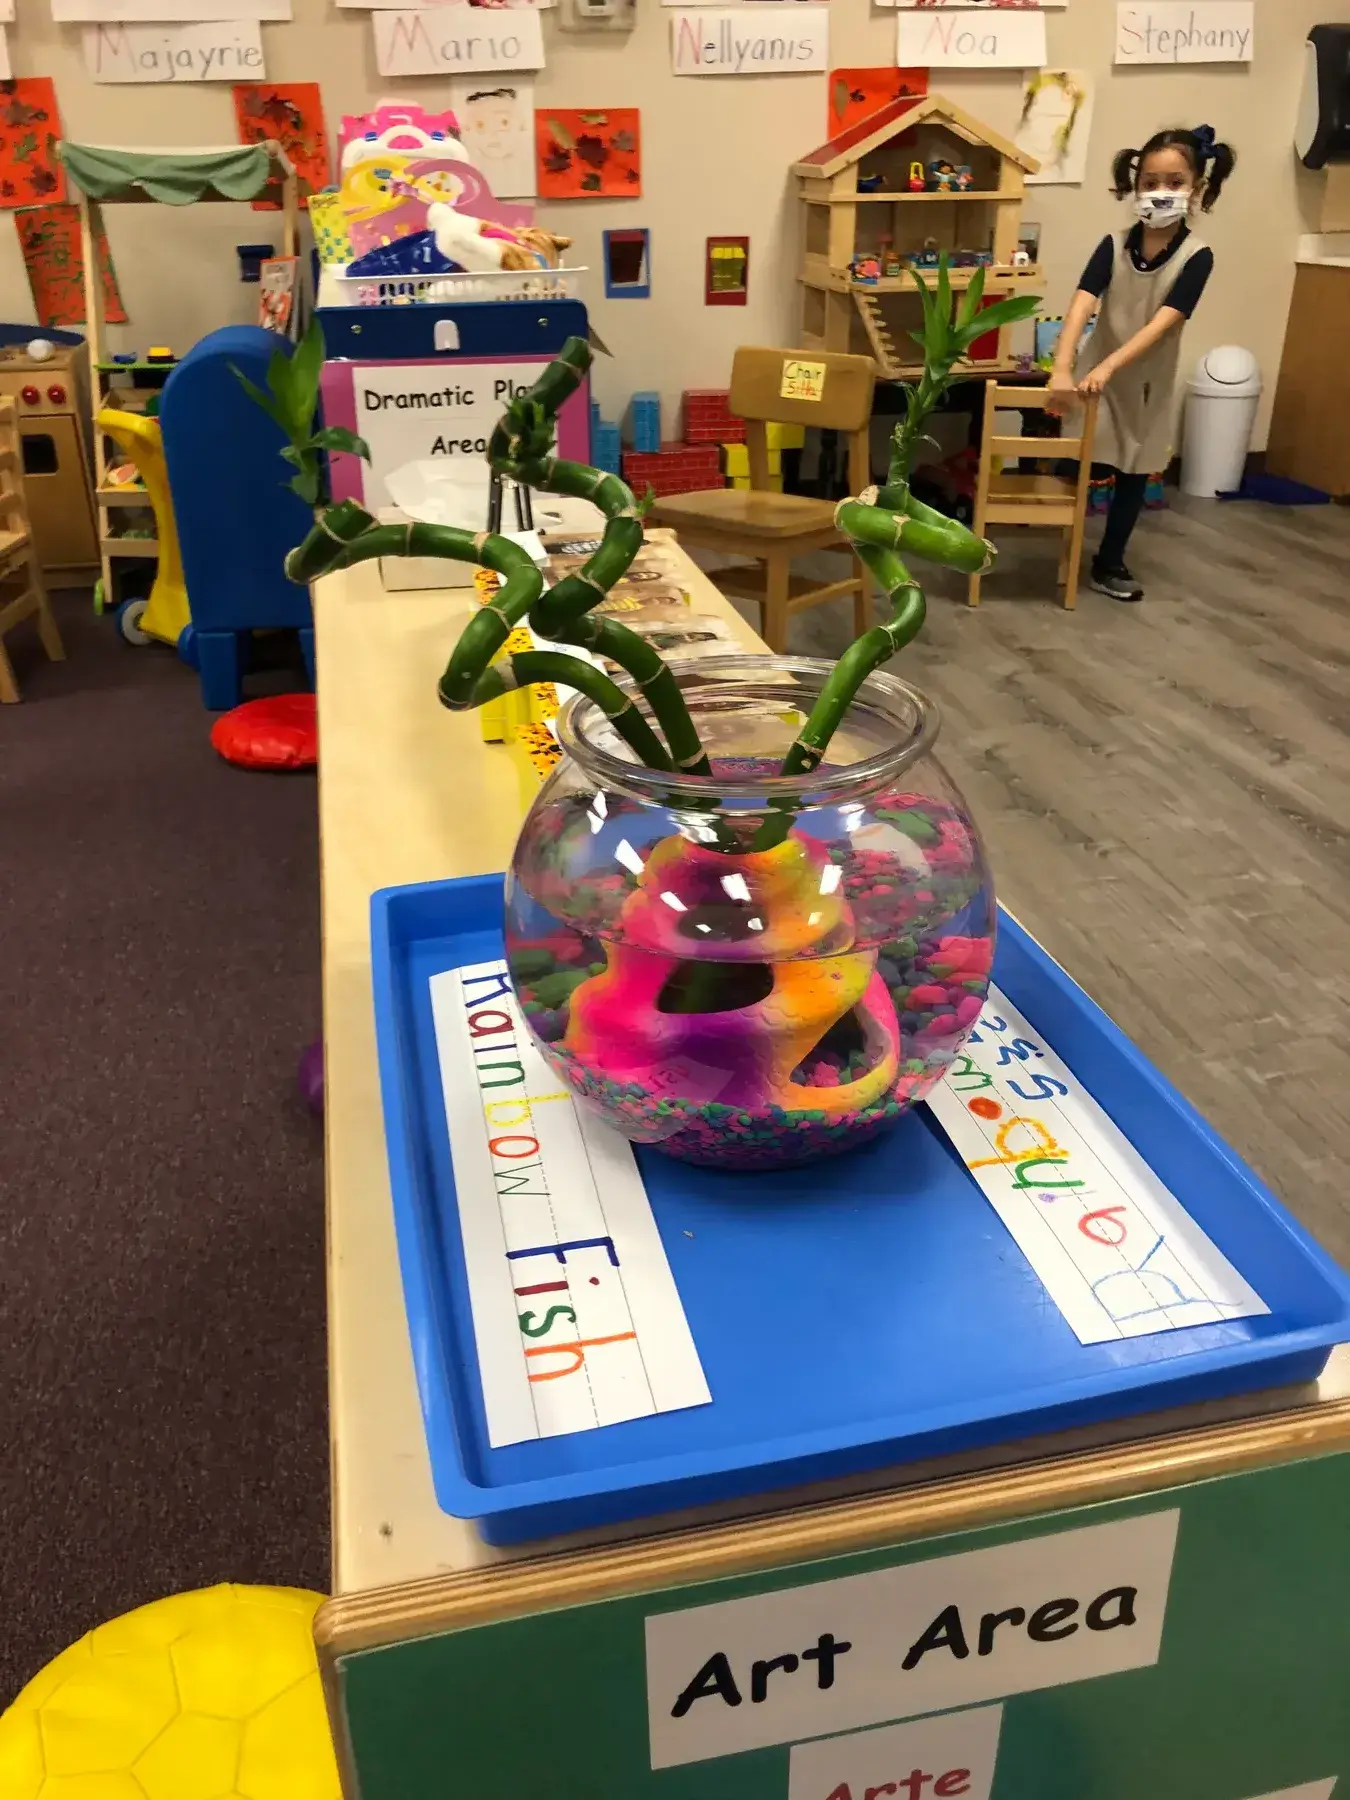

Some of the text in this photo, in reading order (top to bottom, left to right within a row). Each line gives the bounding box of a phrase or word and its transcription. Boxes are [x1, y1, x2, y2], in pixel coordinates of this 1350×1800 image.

[95, 22, 263, 81] Majayrie
[385, 15, 521, 69] Mario
[676, 17, 814, 72] Nellyanis
[921, 15, 998, 56] Noa
[1119, 11, 1250, 62] Stephany
[364, 379, 534, 411] Dramatic Pla
[430, 435, 488, 455] Area
[506, 1236, 637, 1383] Fish
[670, 1586, 1138, 1717] Art Area
